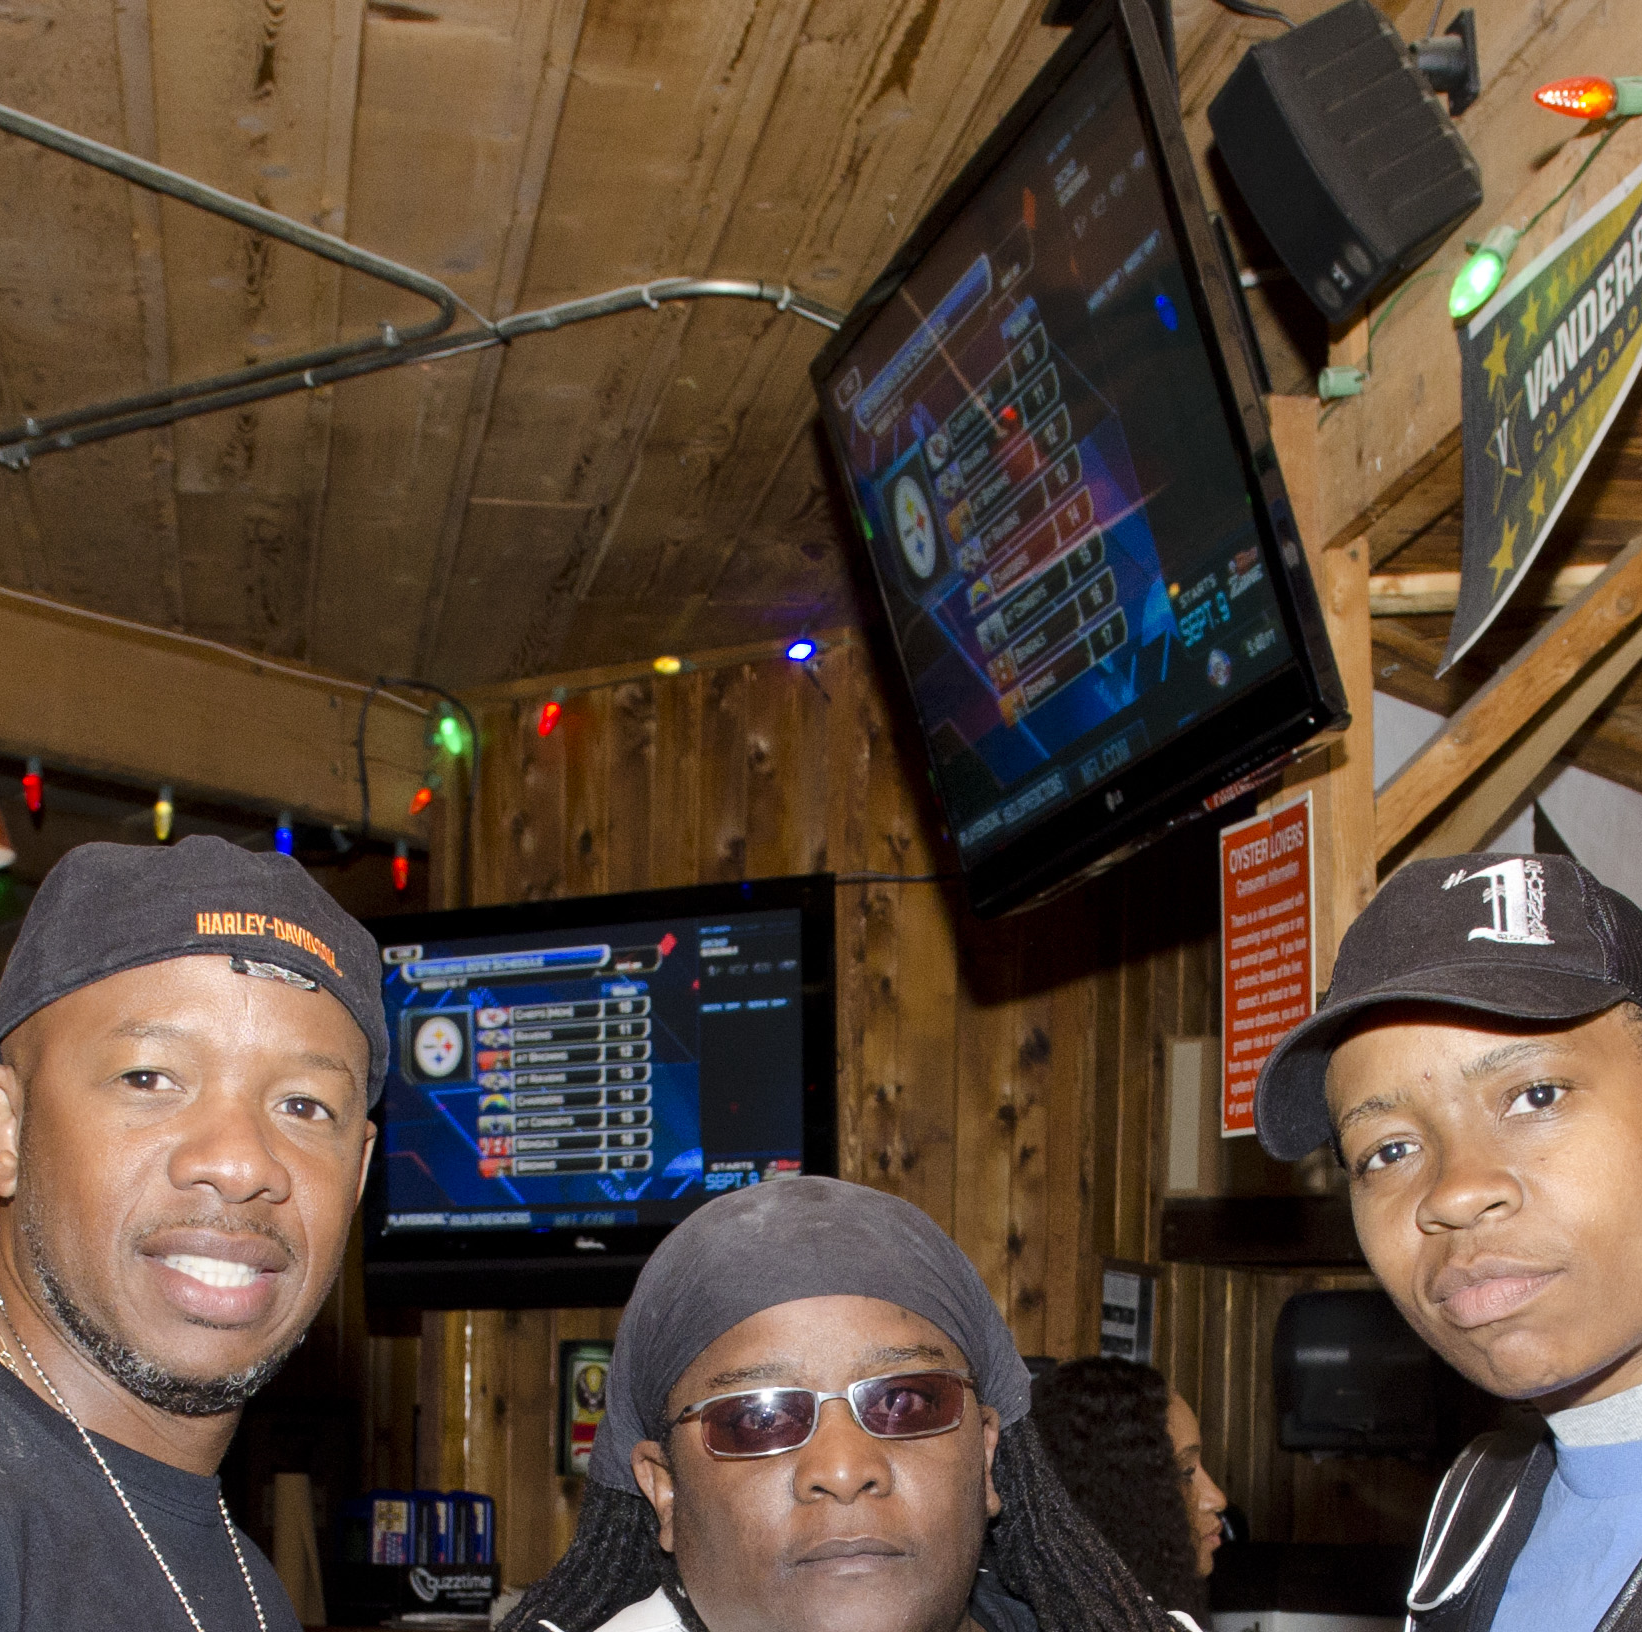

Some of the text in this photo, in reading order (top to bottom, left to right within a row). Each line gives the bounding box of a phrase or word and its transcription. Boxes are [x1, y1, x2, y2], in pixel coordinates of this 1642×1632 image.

[1229, 820, 1305, 874] OYSTER LOVERS
[196, 912, 338, 972] HARLEY-DAVIDSON
